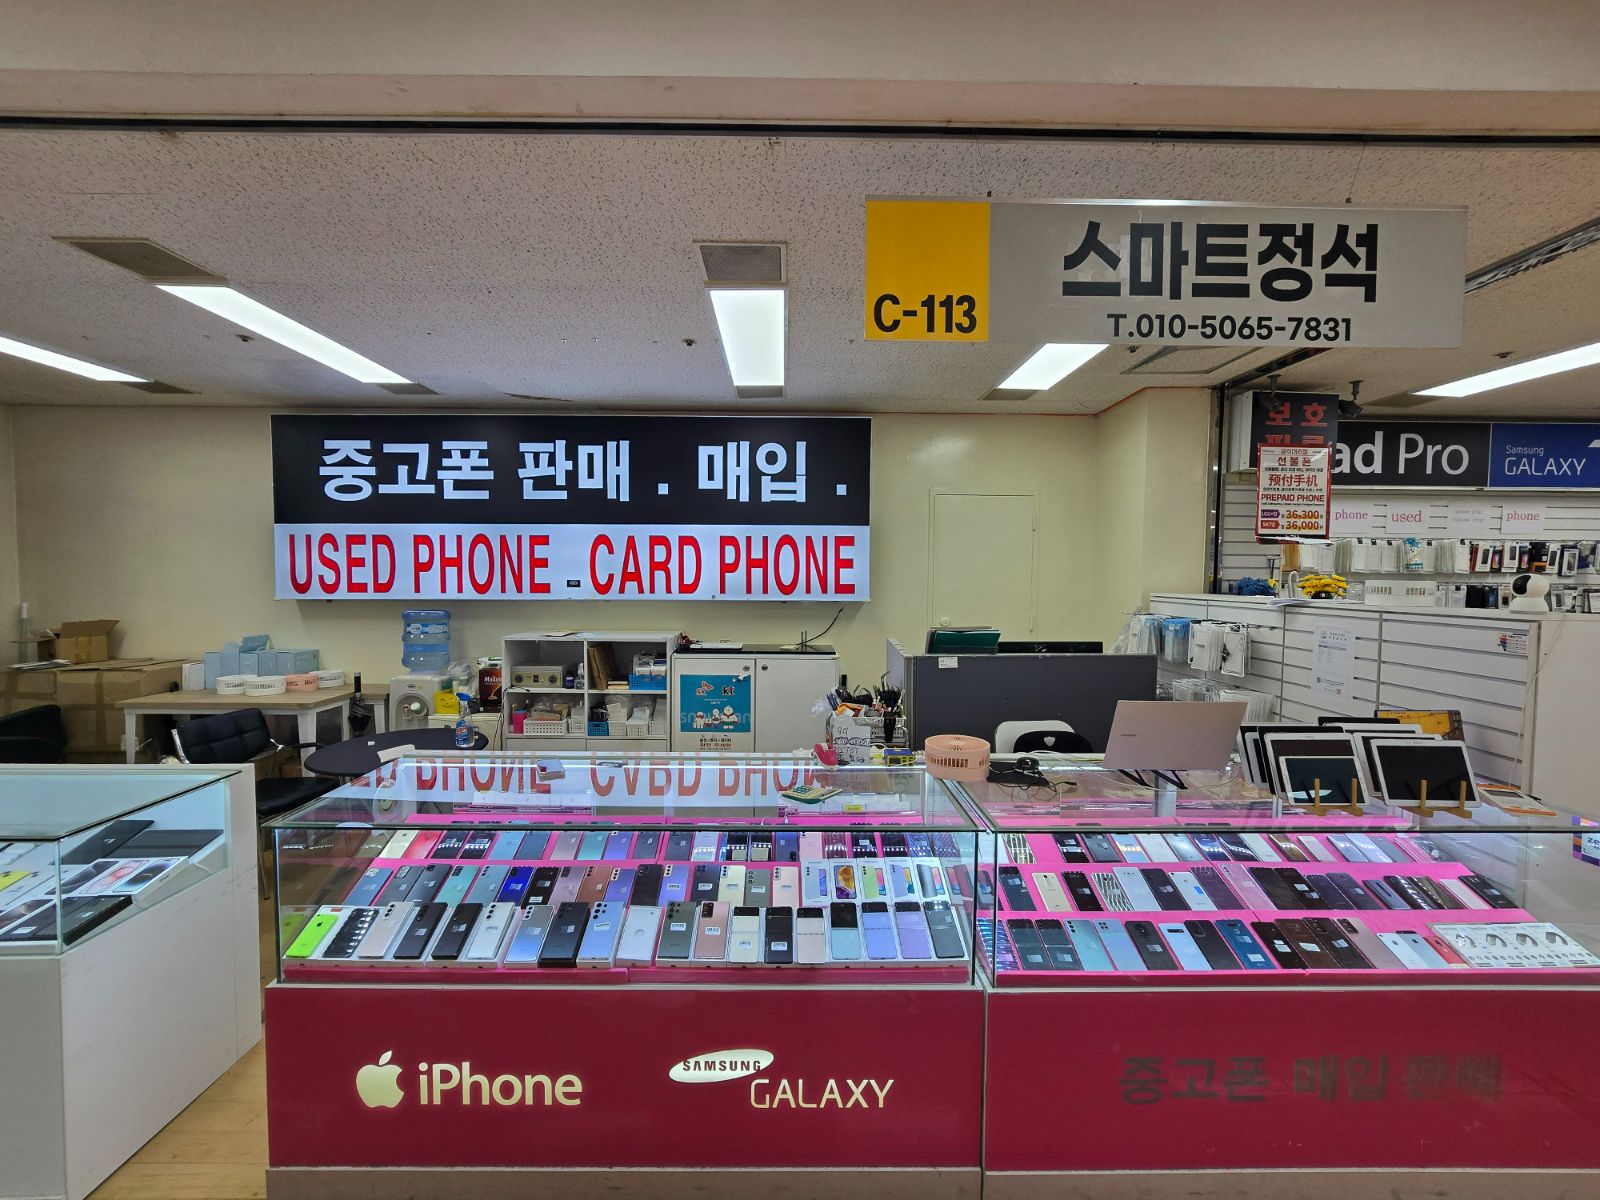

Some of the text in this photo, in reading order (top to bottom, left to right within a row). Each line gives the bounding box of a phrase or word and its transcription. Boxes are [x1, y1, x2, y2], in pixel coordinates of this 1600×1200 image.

[1061, 221, 1379, 303] 스마트정석
[873, 294, 977, 334] C-113
[1107, 313, 1352, 342] T.010-5065-7831
[1333, 431, 1470, 476] ad Pro
[1505, 445, 1545, 456] Samsung
[318, 440, 494, 502] 중고폰
[517, 440, 629, 502] 판매
[698, 440, 807, 502] 매입
[1504, 457, 1587, 476] GALAXY
[1268, 474, 1319, 487] 预付手机
[1261, 493, 1325, 502] PREPAID PHONE
[1334, 509, 1369, 520] phone
[1391, 510, 1422, 523] used
[1506, 510, 1540, 522] phone
[289, 533, 856, 595] USED PHONE CARD PHONE
[722, 685, 735, 696] kt
[682, 1059, 761, 1072] SAMSUNG
[418, 1061, 583, 1106] iPhone
[1119, 1056, 1272, 1104] 중고폰
[1293, 1055, 1388, 1102] 매입
[750, 1079, 894, 1109] GALAXY
